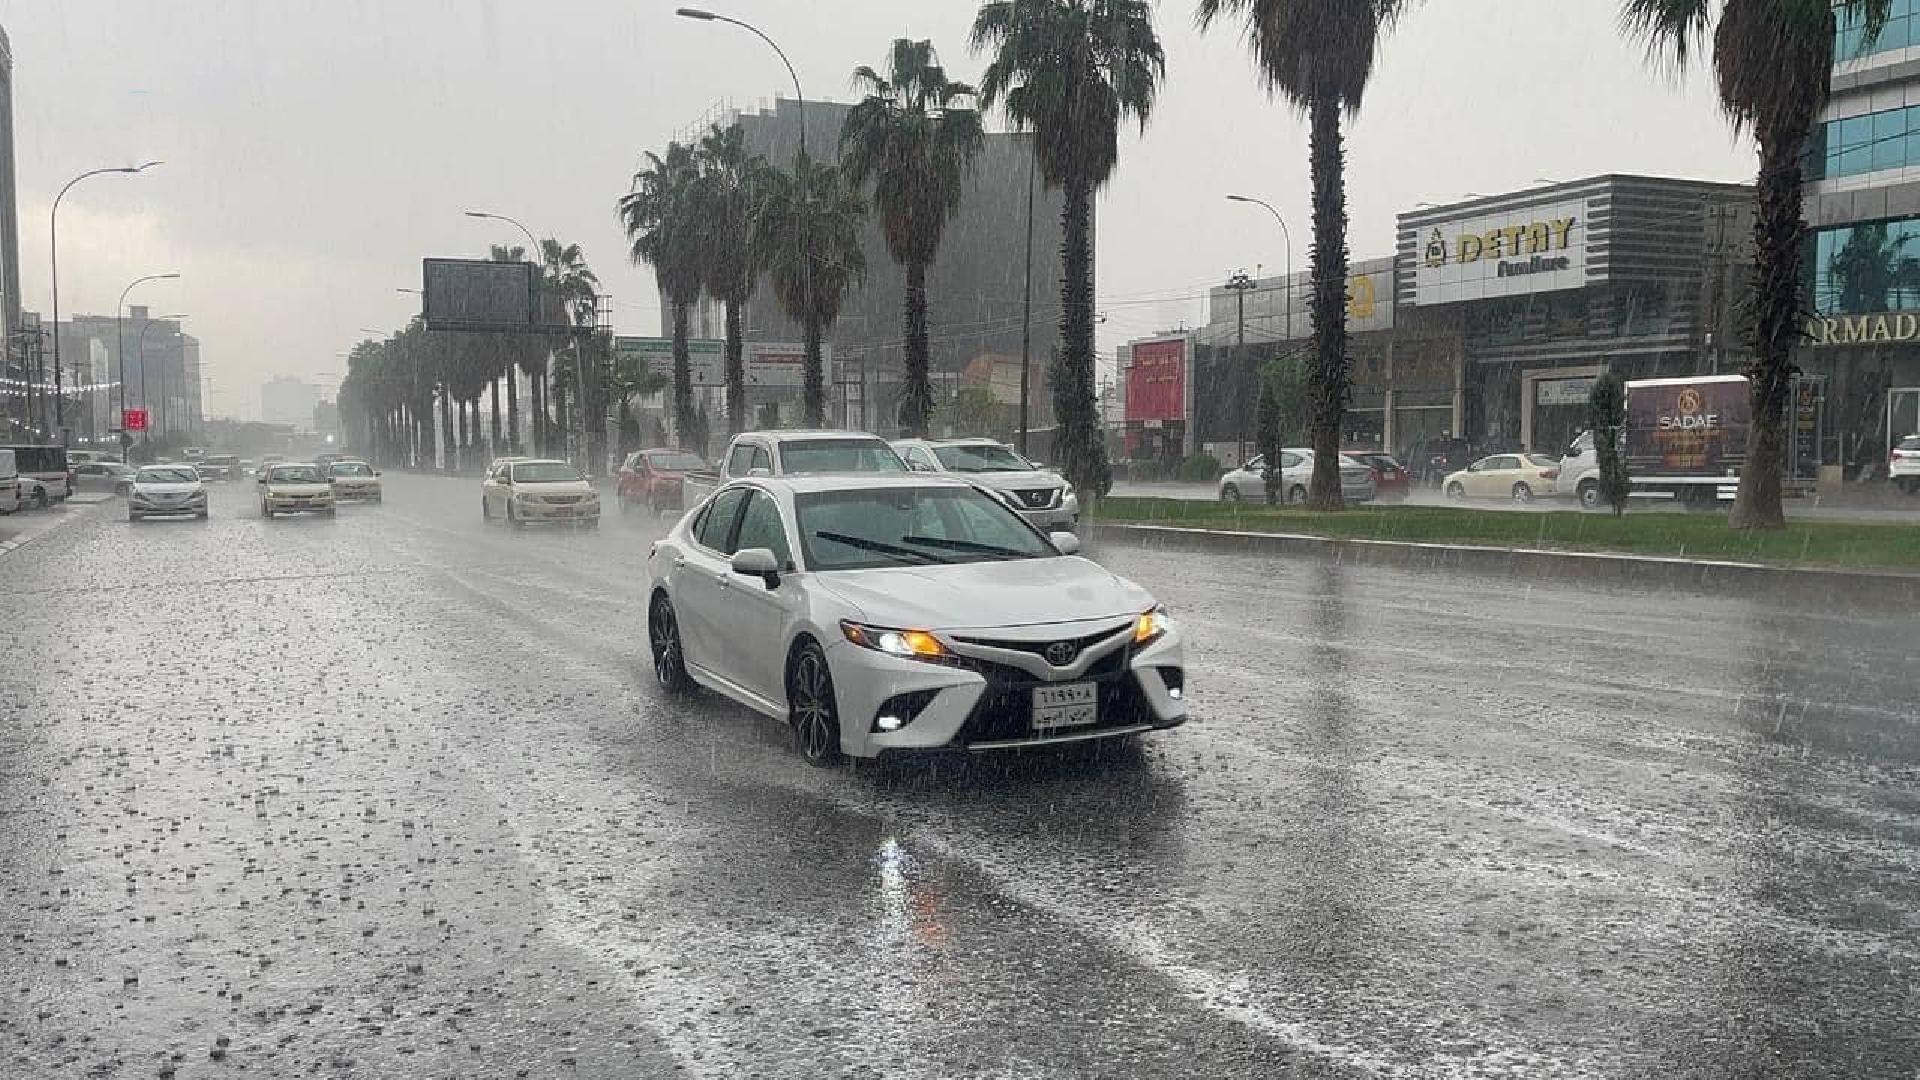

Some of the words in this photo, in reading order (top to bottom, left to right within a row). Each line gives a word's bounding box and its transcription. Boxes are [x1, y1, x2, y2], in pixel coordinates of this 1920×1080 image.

[1456, 216, 1576, 264] DETAY
[1801, 314, 1920, 345] ARMAD
[1659, 414, 1717, 430] SADAF
